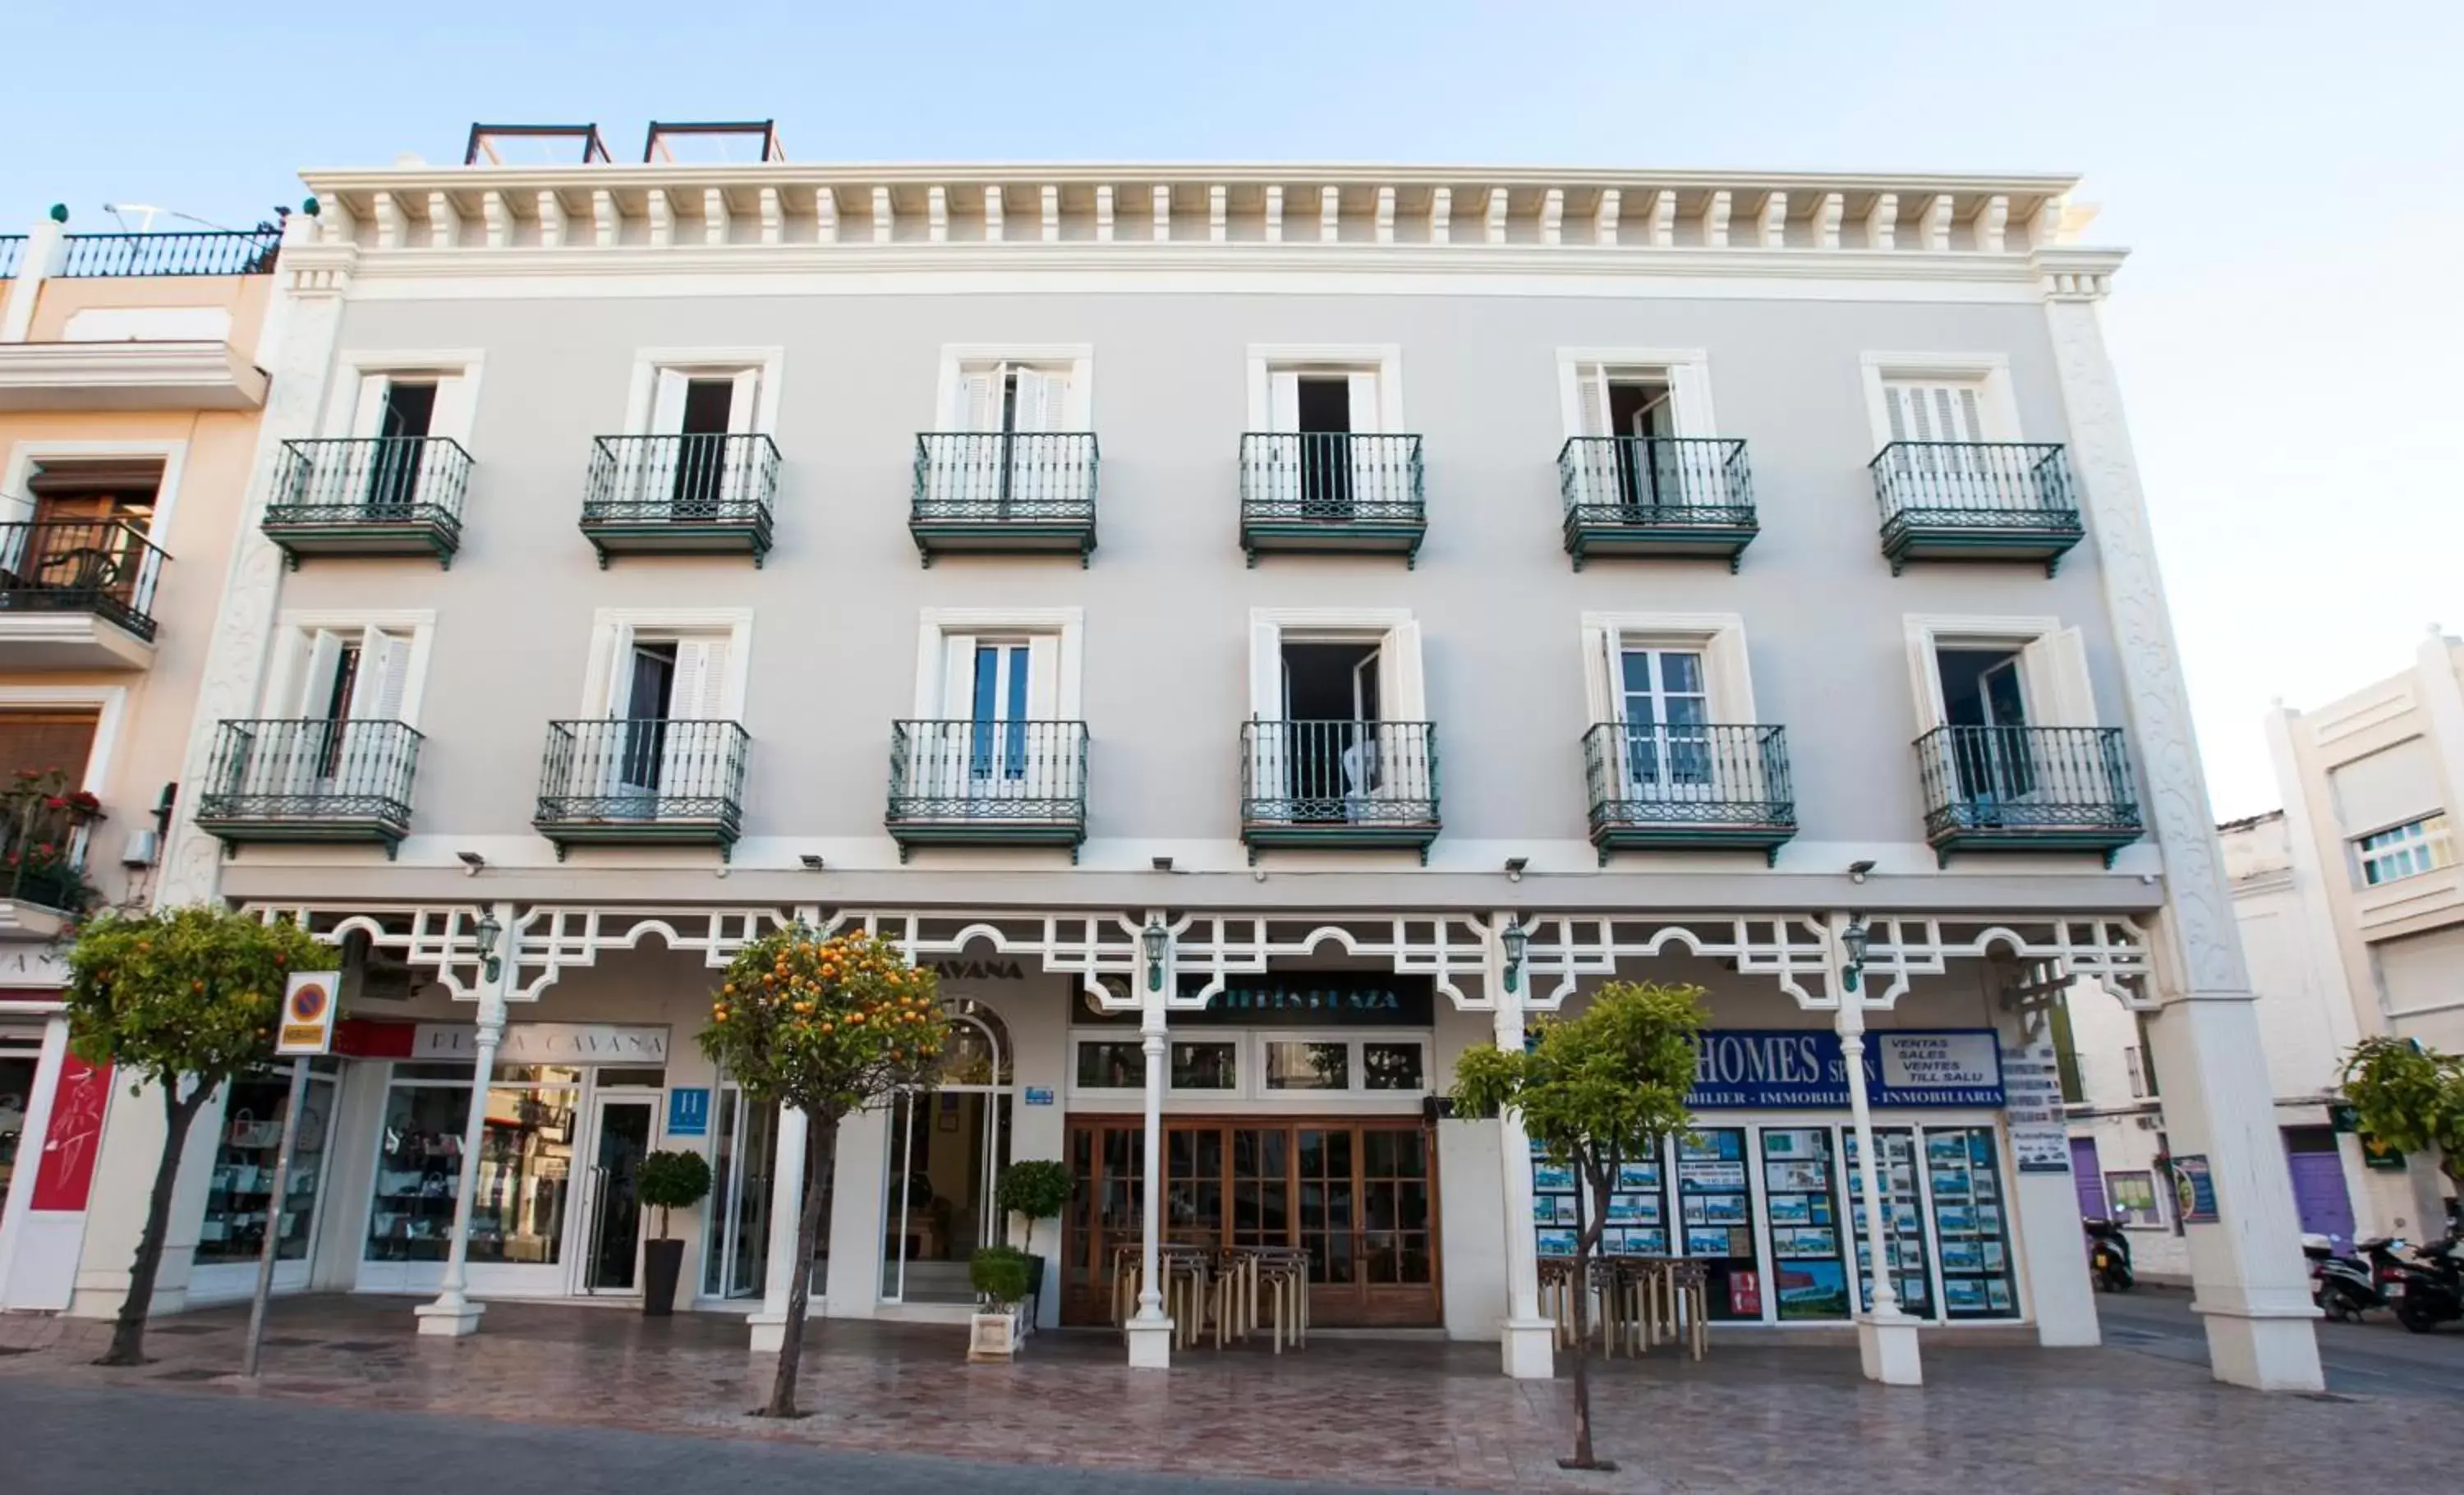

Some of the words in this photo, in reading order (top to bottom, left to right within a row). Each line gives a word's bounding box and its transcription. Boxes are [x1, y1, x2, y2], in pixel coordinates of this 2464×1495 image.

[934, 959, 1025, 979] AVANA
[431, 1032, 526, 1051] PLA
[546, 1034, 662, 1054] CAVANA
[1892, 1039, 1949, 1048] VENTAS
[1694, 1036, 1820, 1083] HOMES
[1827, 1059, 1877, 1083] SPN
[1898, 1050, 1947, 1060] SALES
[1903, 1060, 1961, 1070] VENTES
[1910, 1073, 1939, 1083] TILL
[1682, 1092, 1746, 1105] BILIER
[1760, 1092, 1851, 1105] IMMOBILI
[1882, 1091, 2002, 1104] INMOBILIARIA
